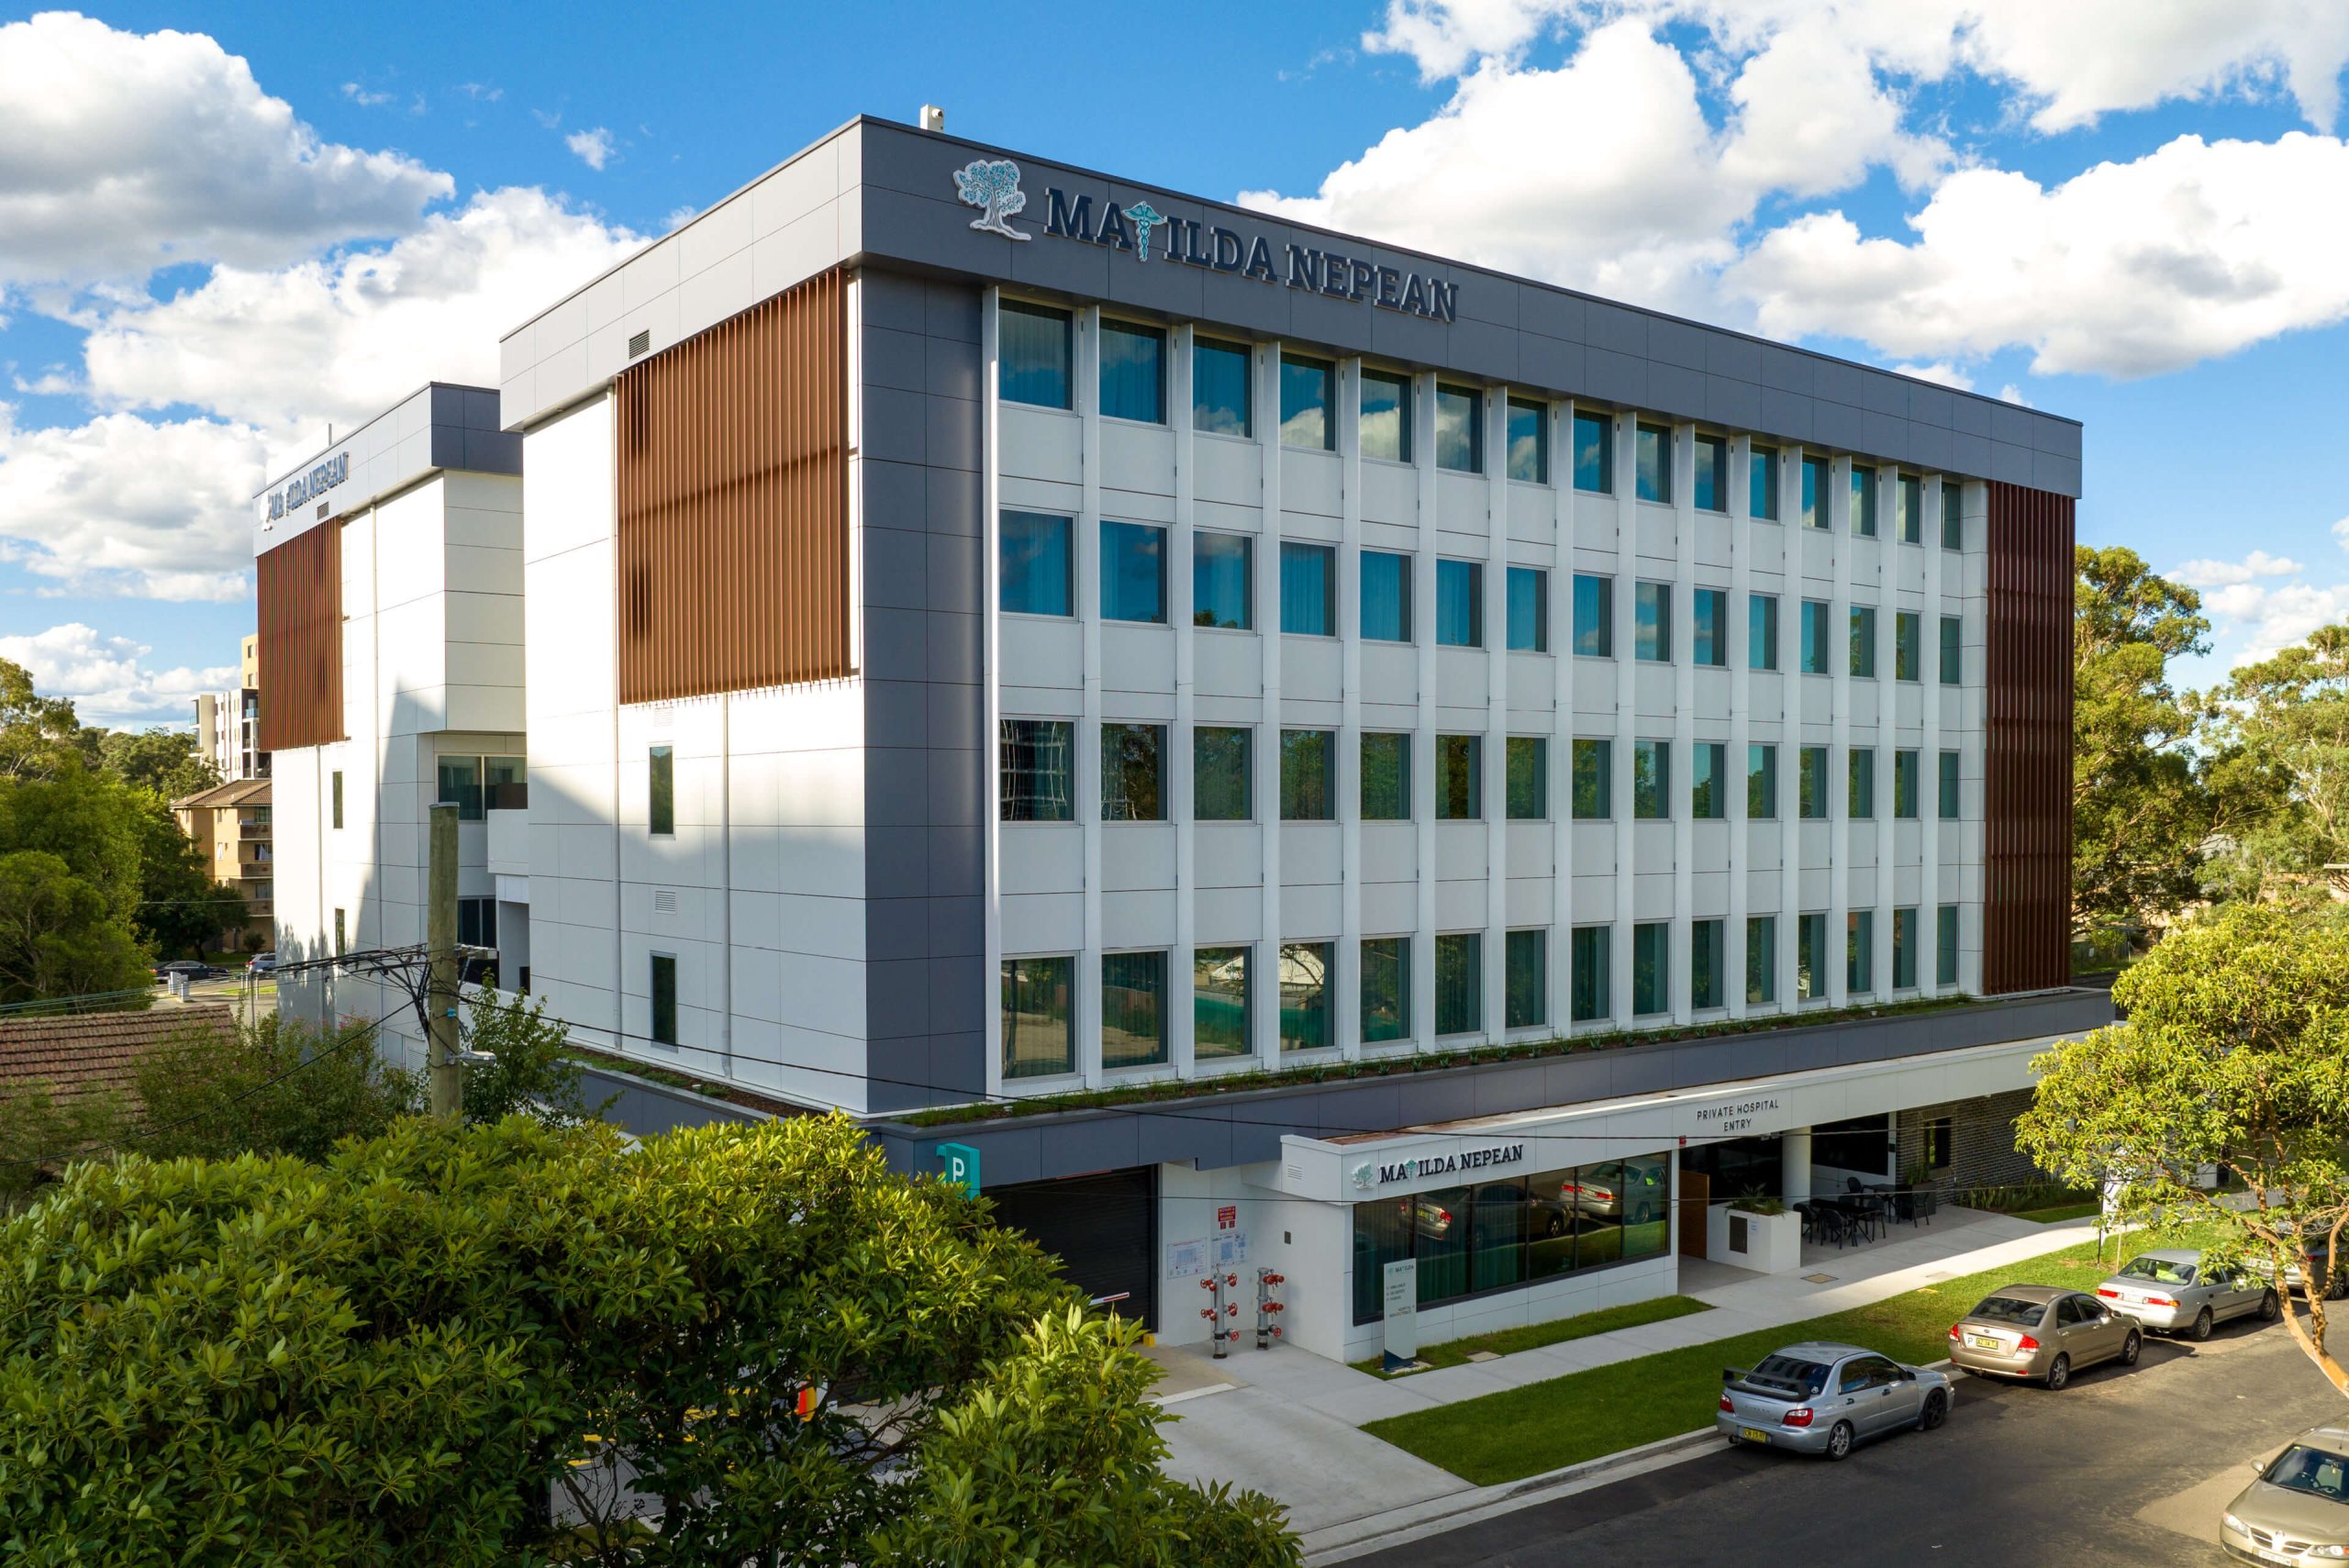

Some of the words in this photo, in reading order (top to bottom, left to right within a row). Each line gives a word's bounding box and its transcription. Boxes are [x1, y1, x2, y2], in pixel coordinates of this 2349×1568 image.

[1043, 186, 1277, 283] MATILDA
[1286, 243, 1460, 323] NEPEAN
[308, 451, 350, 499] NEPEAN
[1697, 1106, 1733, 1121] PRIVATE
[1737, 1099, 1779, 1114] HOSPITAL
[1723, 1118, 1752, 1132] ENTRY
[952, 1156, 965, 1183] P
[1379, 1155, 1456, 1184] MATILDA
[1460, 1144, 1523, 1170] NEPEAN
